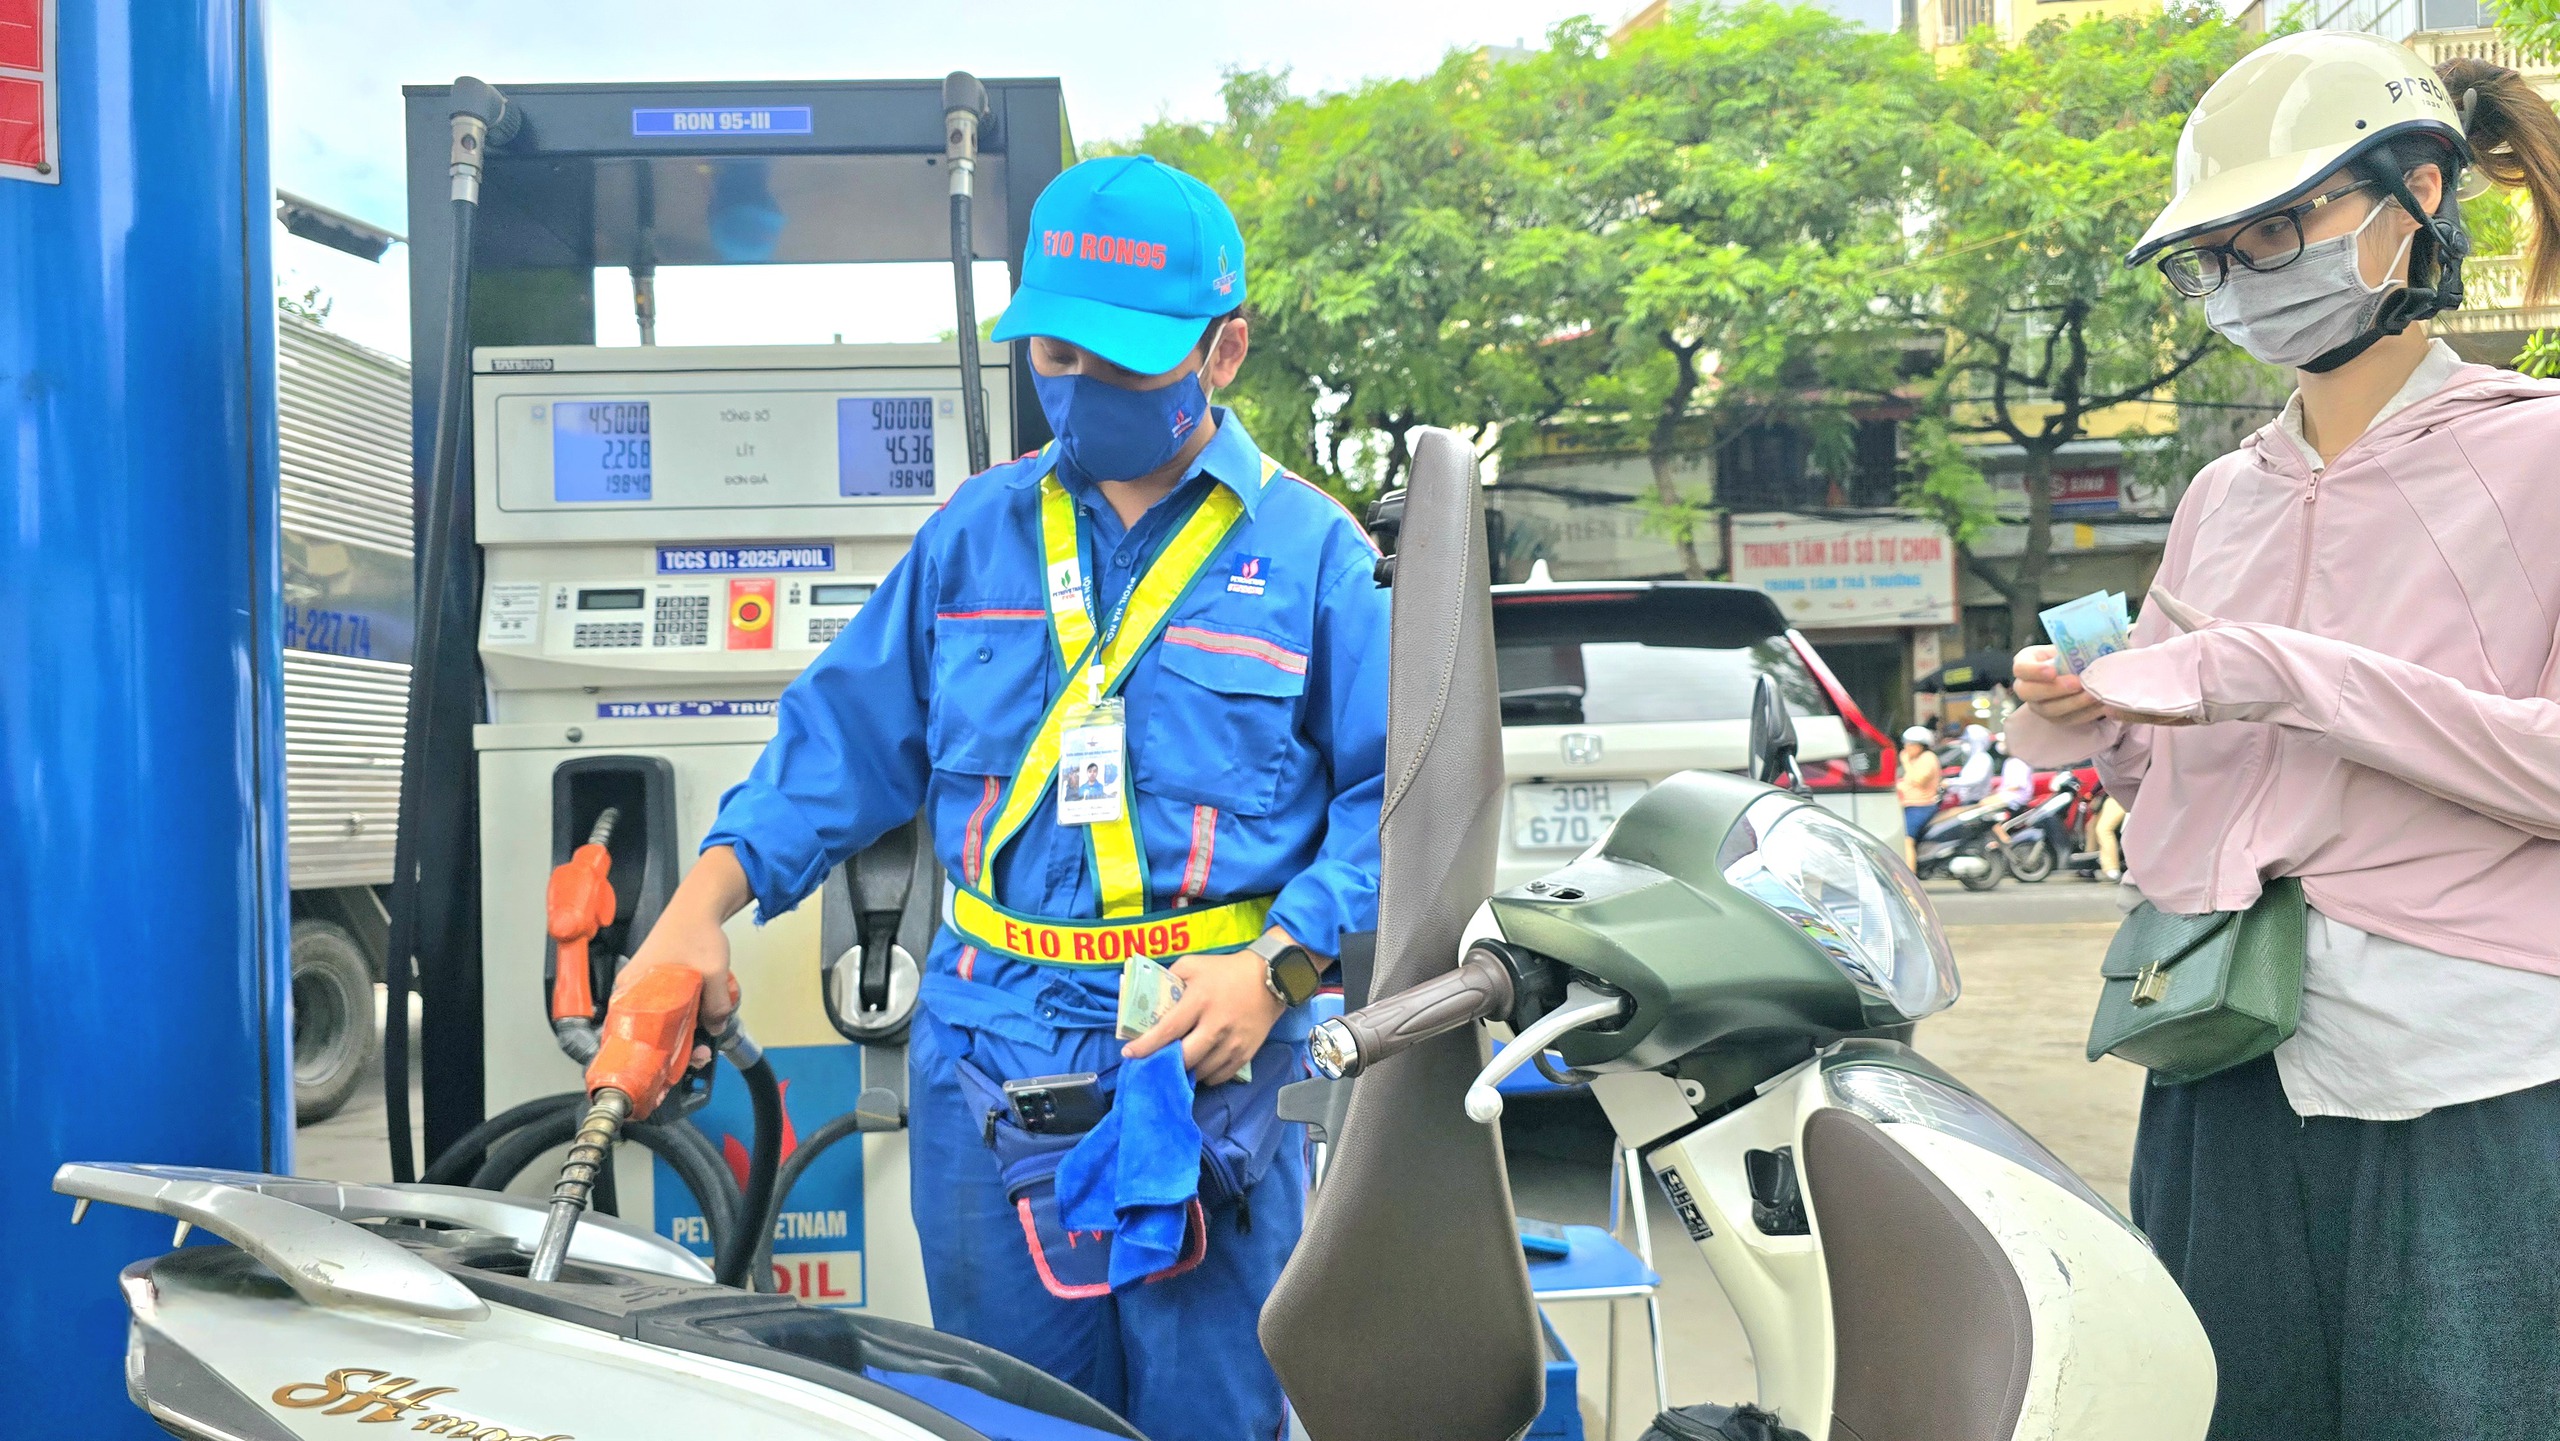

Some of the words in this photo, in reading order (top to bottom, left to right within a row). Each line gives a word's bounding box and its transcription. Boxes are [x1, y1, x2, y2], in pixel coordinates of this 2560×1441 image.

[673, 112, 715, 130] RON
[719, 111, 771, 129] 95-III
[1044, 231, 1074, 257] E10
[1080, 233, 1167, 270] RON95
[589, 405, 650, 435] 45000
[872, 401, 933, 430] 90000
[606, 474, 650, 494] 19840
[889, 469, 934, 488] 19840
[665, 551, 707, 569] TCCS
[709, 550, 735, 568] 01:
[737, 549, 827, 568] 2025/PVOIL
[609, 702, 651, 717] TRẢ
[1552, 786, 1611, 812] 30H
[1004, 921, 1061, 958] E10
[1073, 921, 1191, 961] RON95
[672, 1210, 847, 1243] PETETNAM
[772, 1261, 846, 1299] OIL
[272, 1368, 459, 1422] SH
